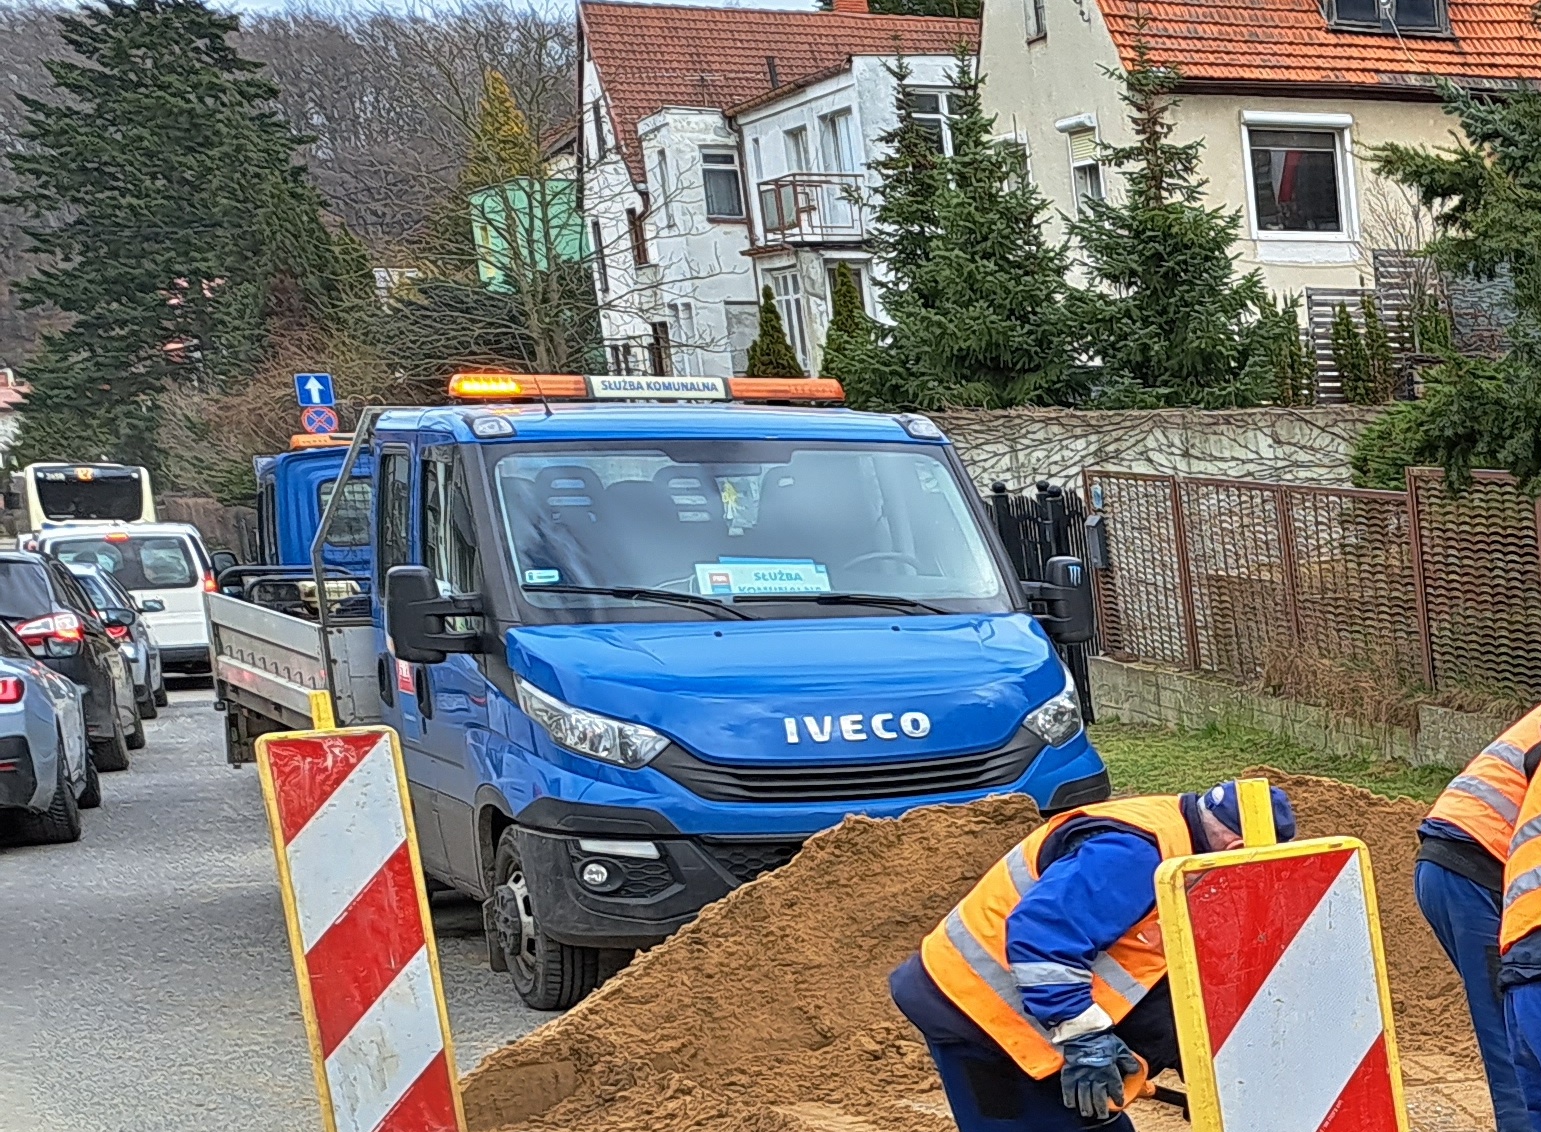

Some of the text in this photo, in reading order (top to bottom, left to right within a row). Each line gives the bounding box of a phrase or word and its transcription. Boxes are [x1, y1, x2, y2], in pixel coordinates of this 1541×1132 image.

[601, 378, 718, 392] SŁUŻBA KOMUNALNA
[753, 570, 803, 581] SŁUŻBA
[784, 711, 931, 744] IVECO
